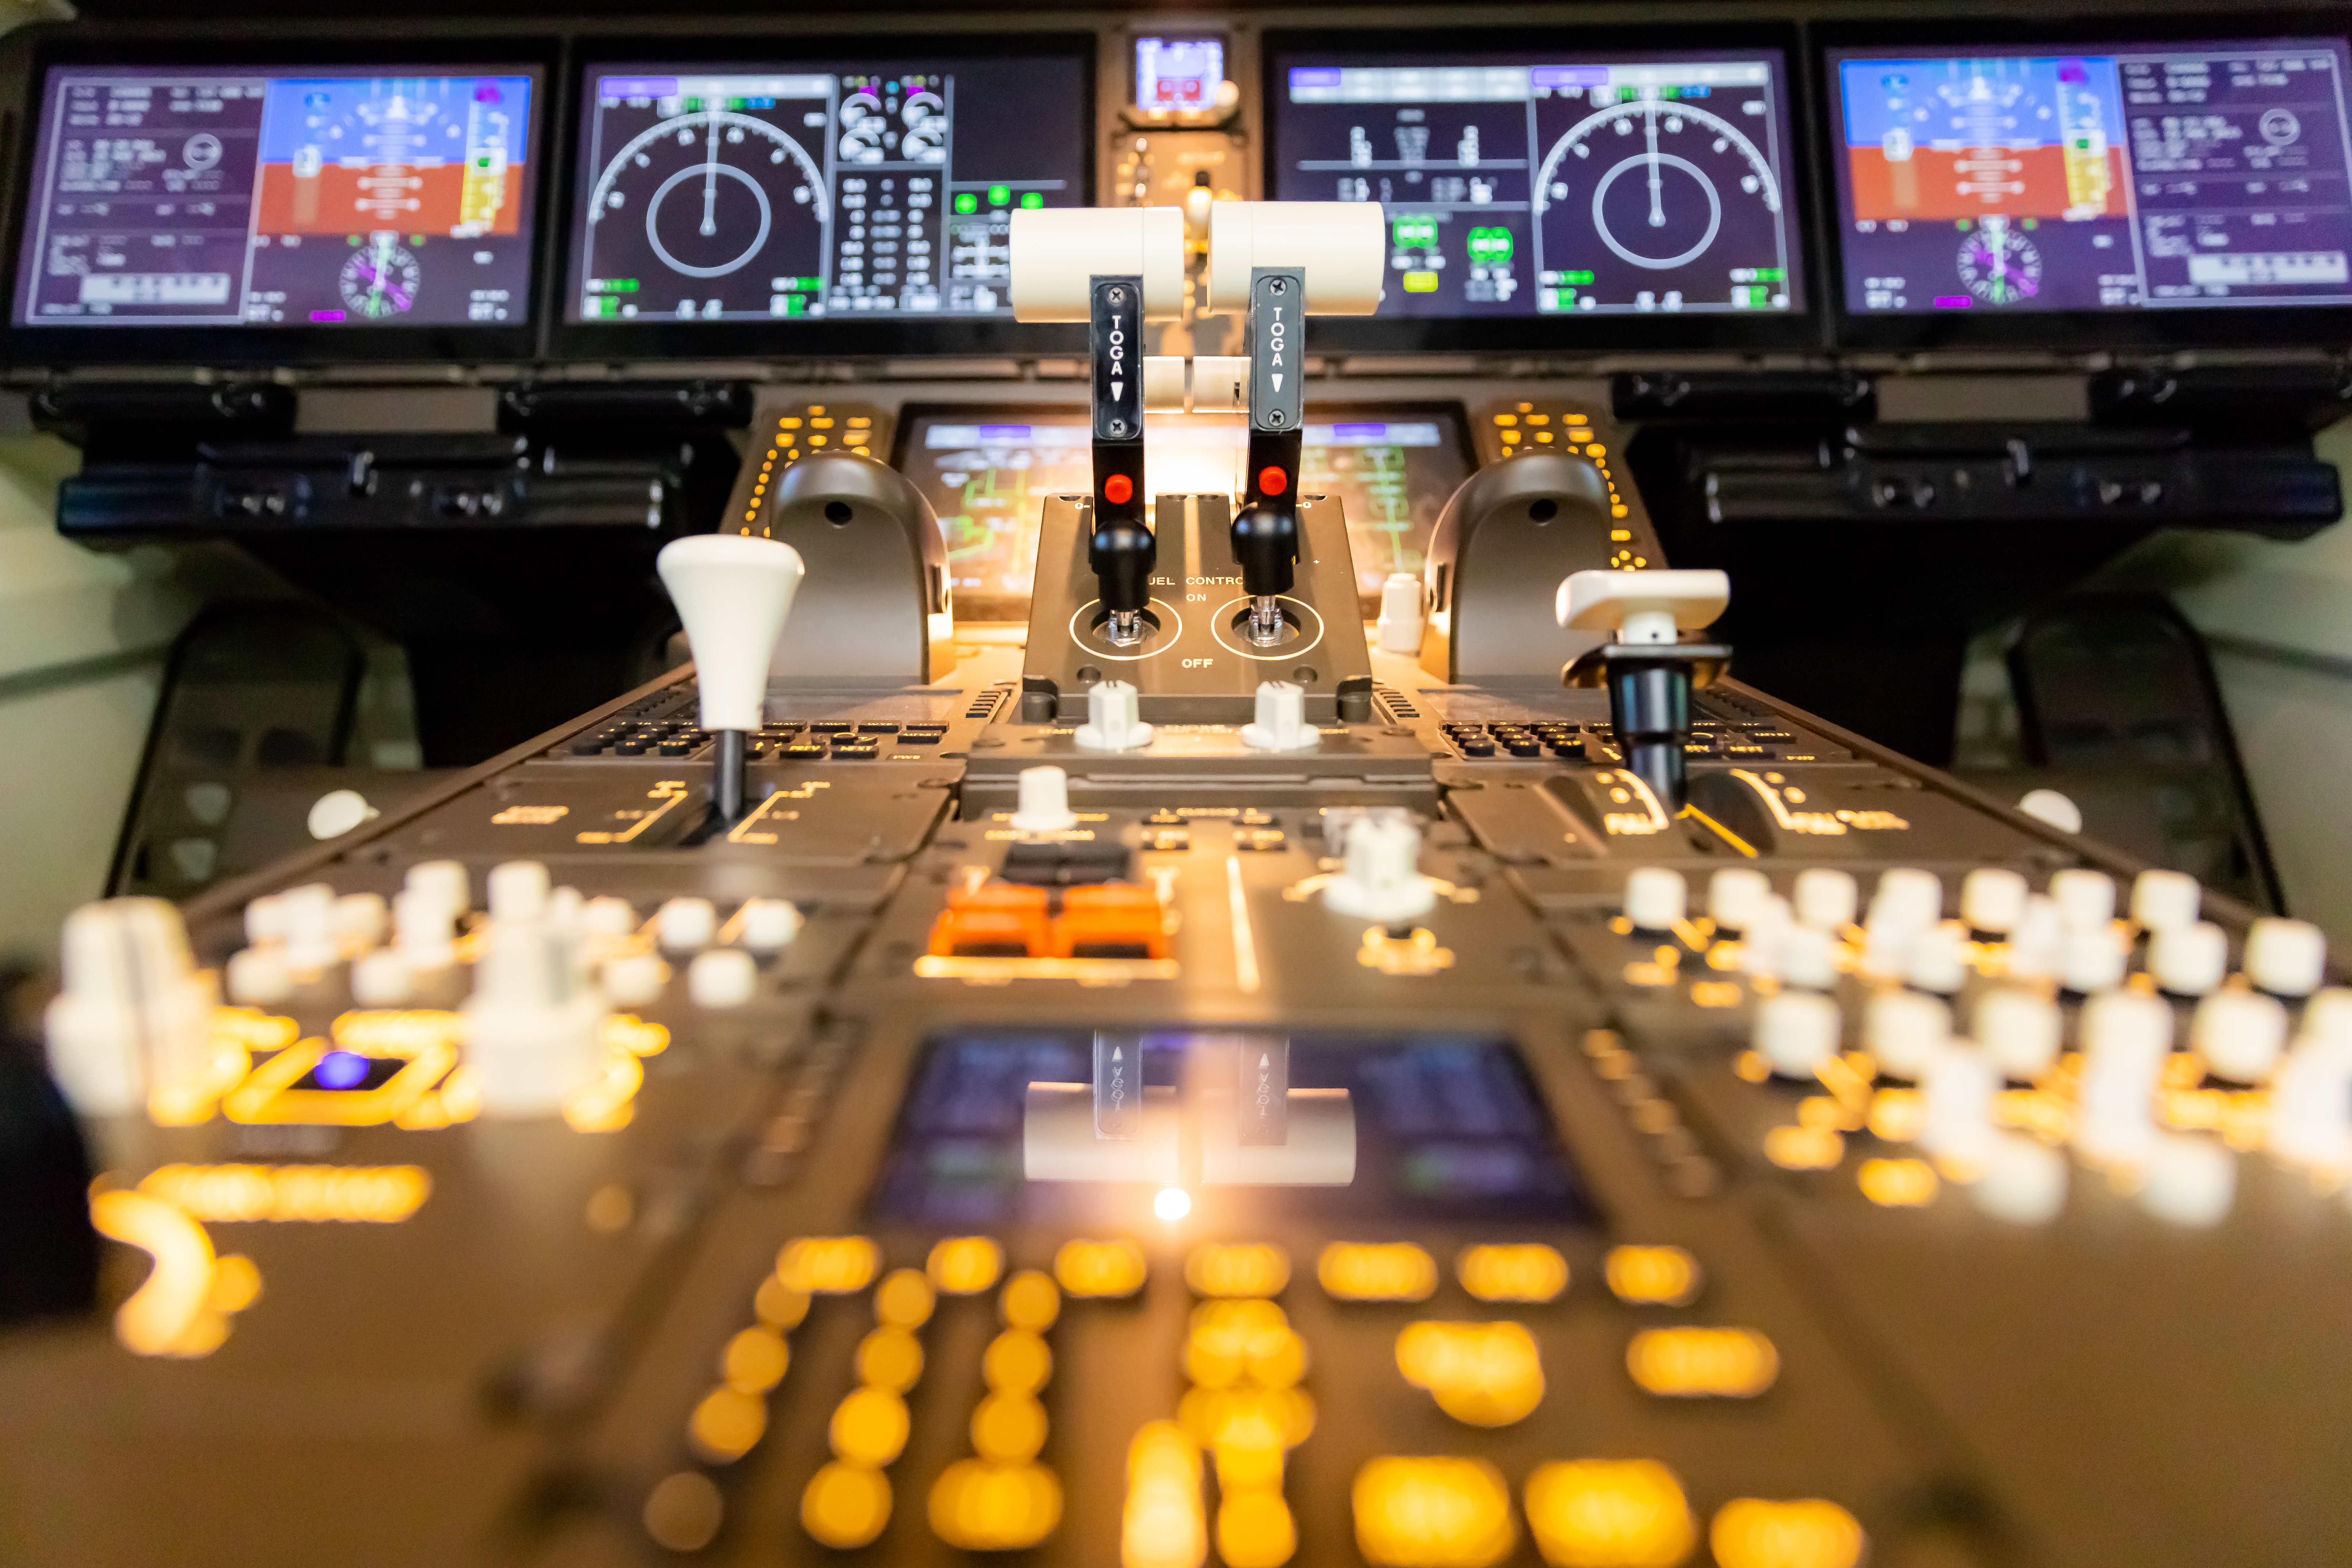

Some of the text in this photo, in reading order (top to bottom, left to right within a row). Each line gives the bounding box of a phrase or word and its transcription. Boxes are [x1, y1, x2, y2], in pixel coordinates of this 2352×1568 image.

[1271, 307, 1285, 366] TOGA
[1109, 315, 1124, 375] TOGA
[1149, 577, 1244, 585] UEL CONTRO
[1186, 593, 1206, 602] ON
[1181, 658, 1214, 668] OFF
